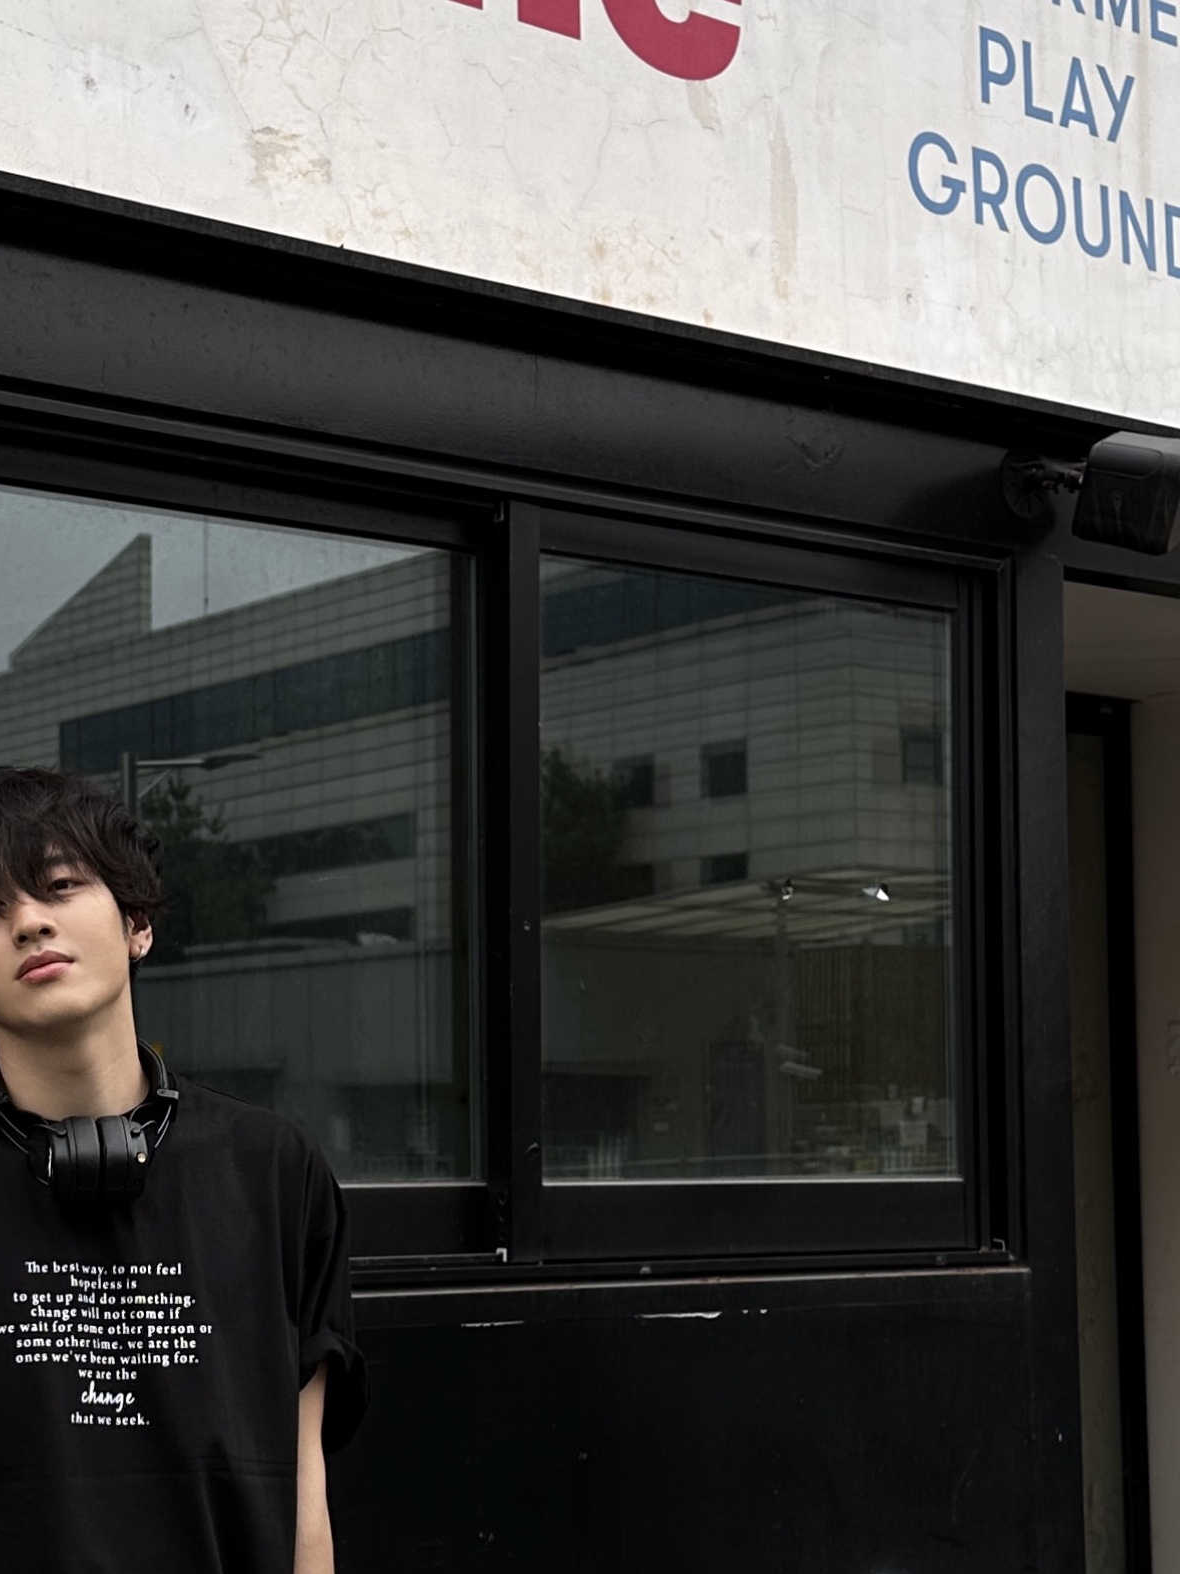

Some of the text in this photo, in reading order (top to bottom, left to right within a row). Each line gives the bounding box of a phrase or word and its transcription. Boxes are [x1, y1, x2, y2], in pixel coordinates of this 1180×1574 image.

[979, 25, 1135, 143] PLAY
[25, 1261, 48, 1273] The
[53, 1261, 79, 1273] best
[113, 1265, 125, 1274] to
[130, 1265, 151, 1275] not
[157, 1263, 181, 1275] feel
[71, 1275, 136, 1291] hopeless is
[13, 1292, 27, 1302] to
[32, 1293, 51, 1306] get
[56, 1294, 73, 1306] up
[78, 1292, 95, 1304] and
[100, 1293, 116, 1304] do
[31, 1306, 181, 1321] change will not come if
[20, 1321, 48, 1332] wait
[52, 1321, 72, 1332] for
[78, 1324, 103, 1334] some
[108, 1323, 142, 1334] other
[148, 1325, 194, 1338] person
[200, 1325, 212, 1334] or
[16, 1338, 51, 1348] some
[56, 1335, 90, 1347] other
[128, 1341, 143, 1349] we
[148, 1340, 169, 1349] are
[174, 1336, 196, 1348] the
[16, 1353, 48, 1363] ones
[90, 1352, 115, 1364] been
[120, 1353, 169, 1367] waiting
[78, 1368, 137, 1380] we are the
[81, 1380, 135, 1413] change
[71, 1412, 93, 1424] that
[98, 1416, 111, 1425] we
